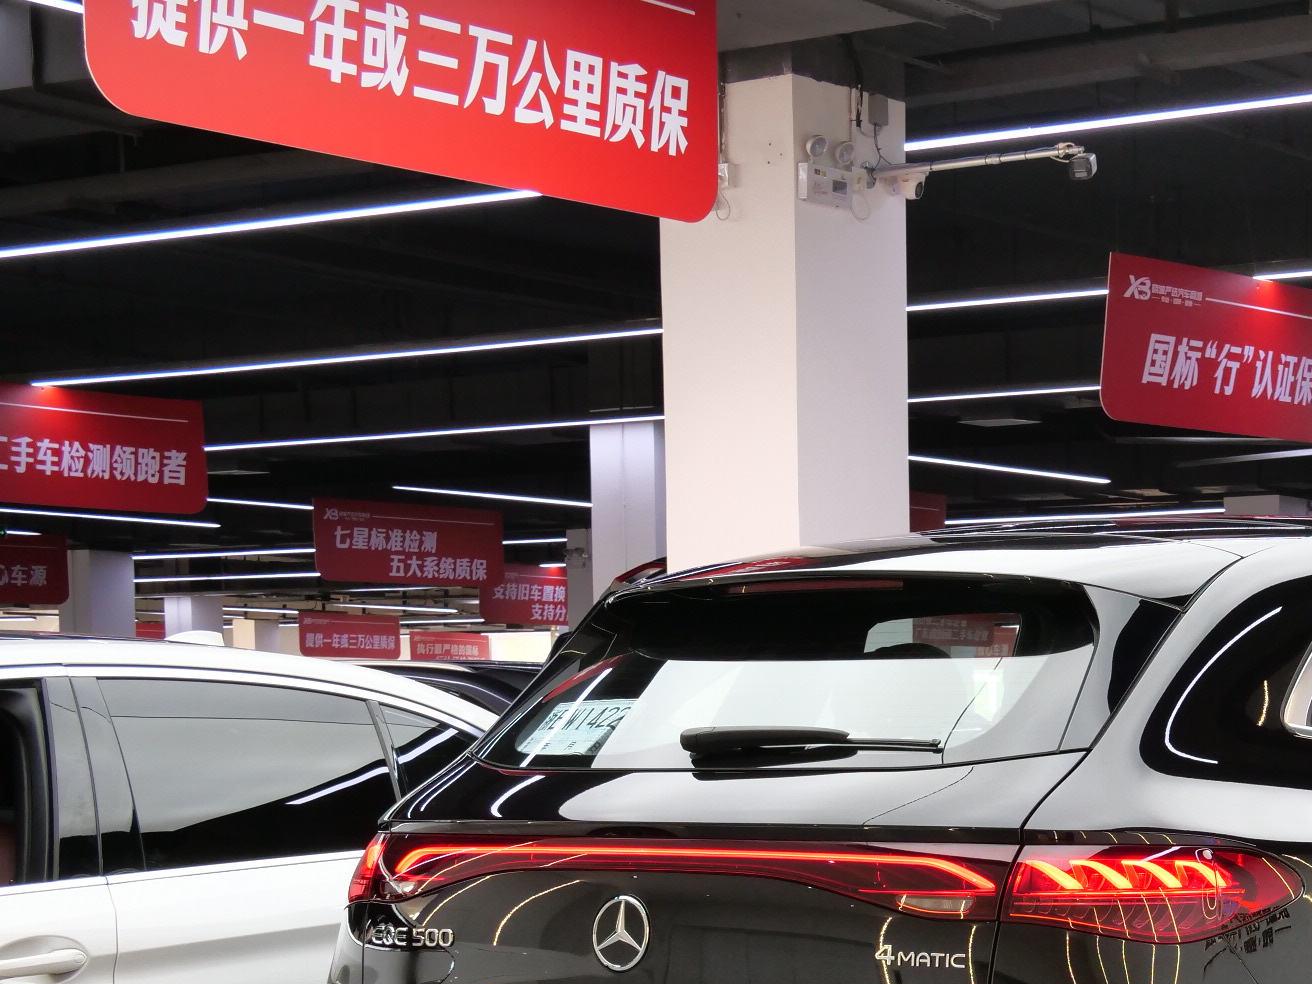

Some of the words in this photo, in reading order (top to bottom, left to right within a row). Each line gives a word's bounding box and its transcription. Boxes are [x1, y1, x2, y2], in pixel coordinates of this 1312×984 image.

[334, 525, 438, 553] 七星标准检测
[389, 555, 487, 580] 五大系统质保
[493, 583, 566, 602] 支持旧车置换
[305, 633, 396, 650] 提供一年或三万公里质保
[372, 925, 408, 946] EQE
[412, 928, 454, 947] 500
[875, 944, 966, 968] 4MATIC
